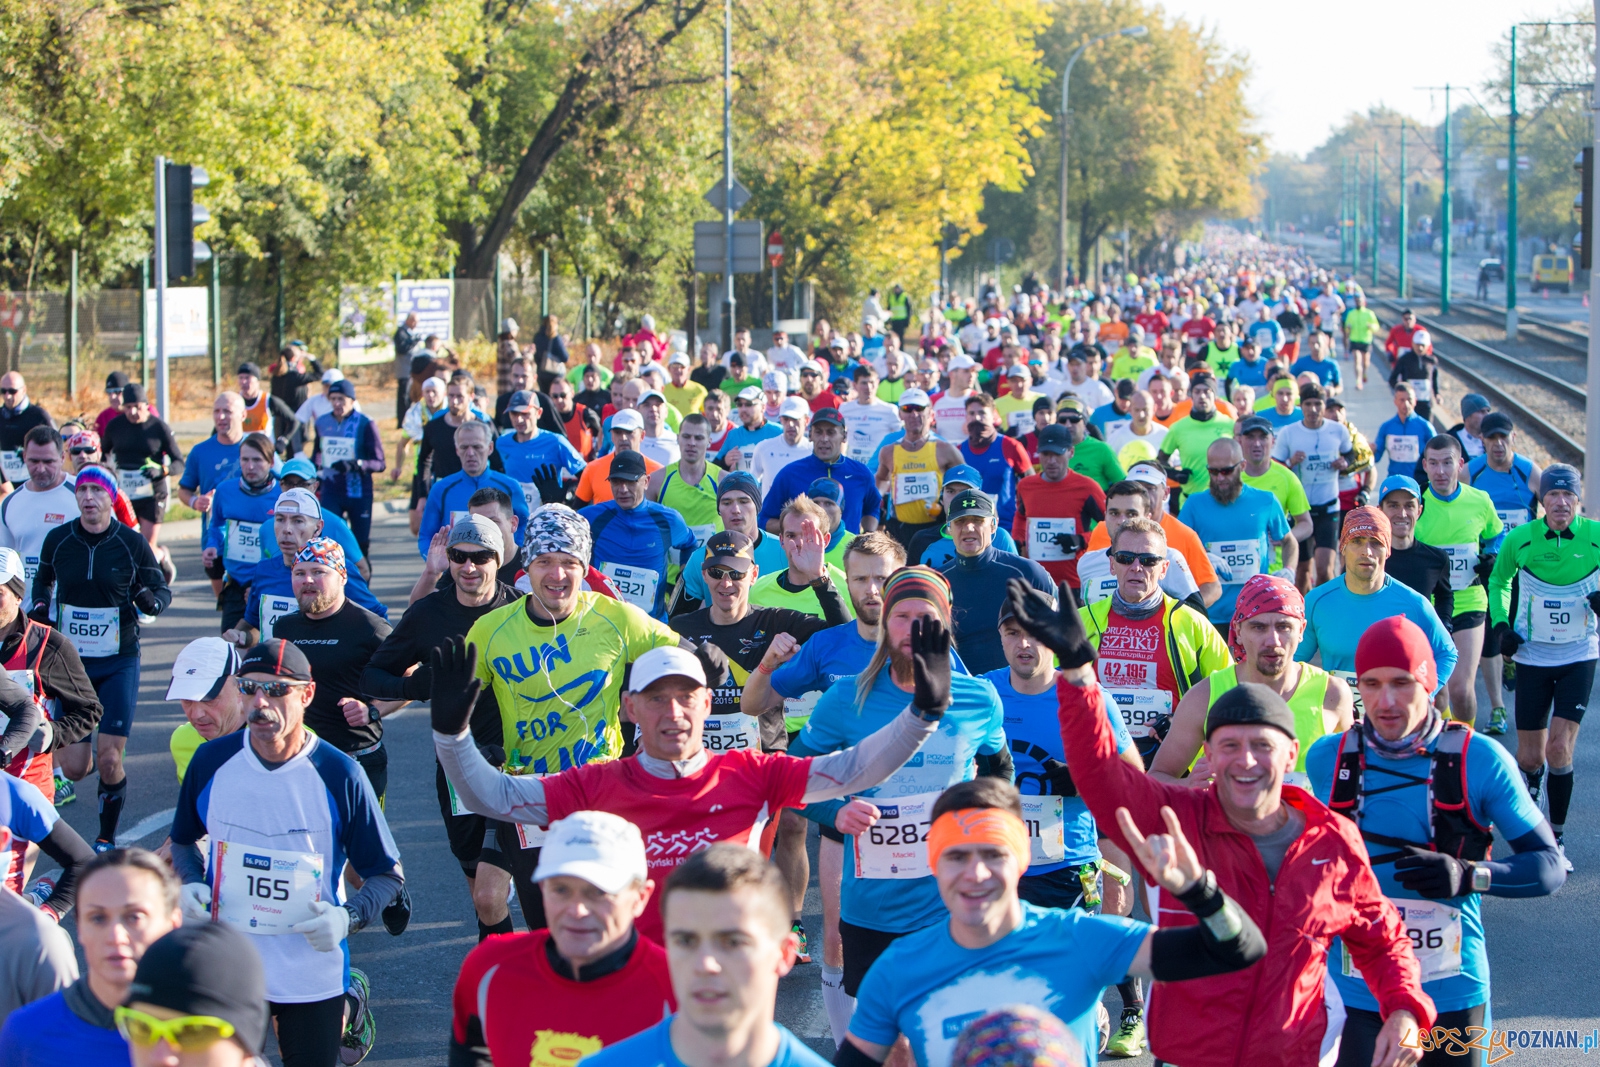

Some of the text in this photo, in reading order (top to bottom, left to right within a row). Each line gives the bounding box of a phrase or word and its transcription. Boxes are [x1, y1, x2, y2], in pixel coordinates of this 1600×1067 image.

[903, 484, 930, 496] 5019
[1549, 612, 1571, 625] 50
[69, 622, 110, 637] 6687
[1101, 635, 1159, 651] SZPIKU
[492, 633, 573, 685] RUN
[1101, 650, 1154, 660] www.darszpiku.pl
[515, 711, 569, 742] FOR
[892, 775, 916, 784] SIŁA
[892, 851, 916, 859] Maciej
[245, 856, 270, 868] 16. PKO
[246, 874, 290, 902] 165
[252, 903, 283, 915] Wiesław
[1406, 927, 1444, 950] 86
